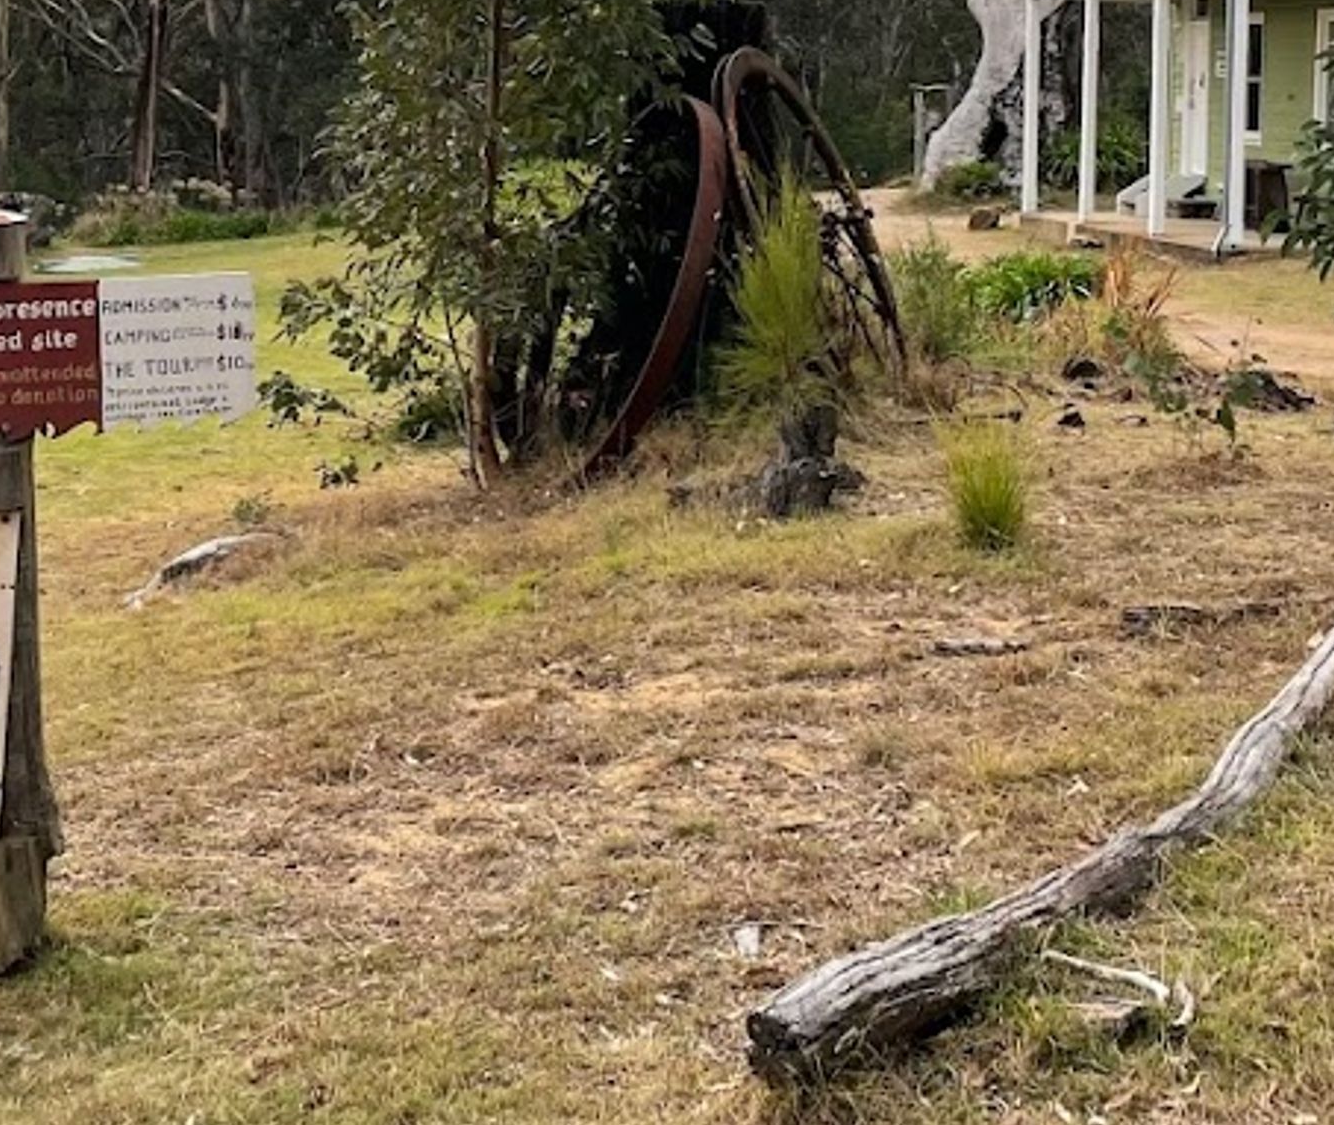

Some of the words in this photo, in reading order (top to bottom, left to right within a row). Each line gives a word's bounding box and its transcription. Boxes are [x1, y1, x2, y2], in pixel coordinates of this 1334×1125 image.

[30, 328, 78, 352] site
[104, 328, 172, 346] CAMPING
[105, 361, 135, 378] THE
[10, 384, 99, 407] donation
